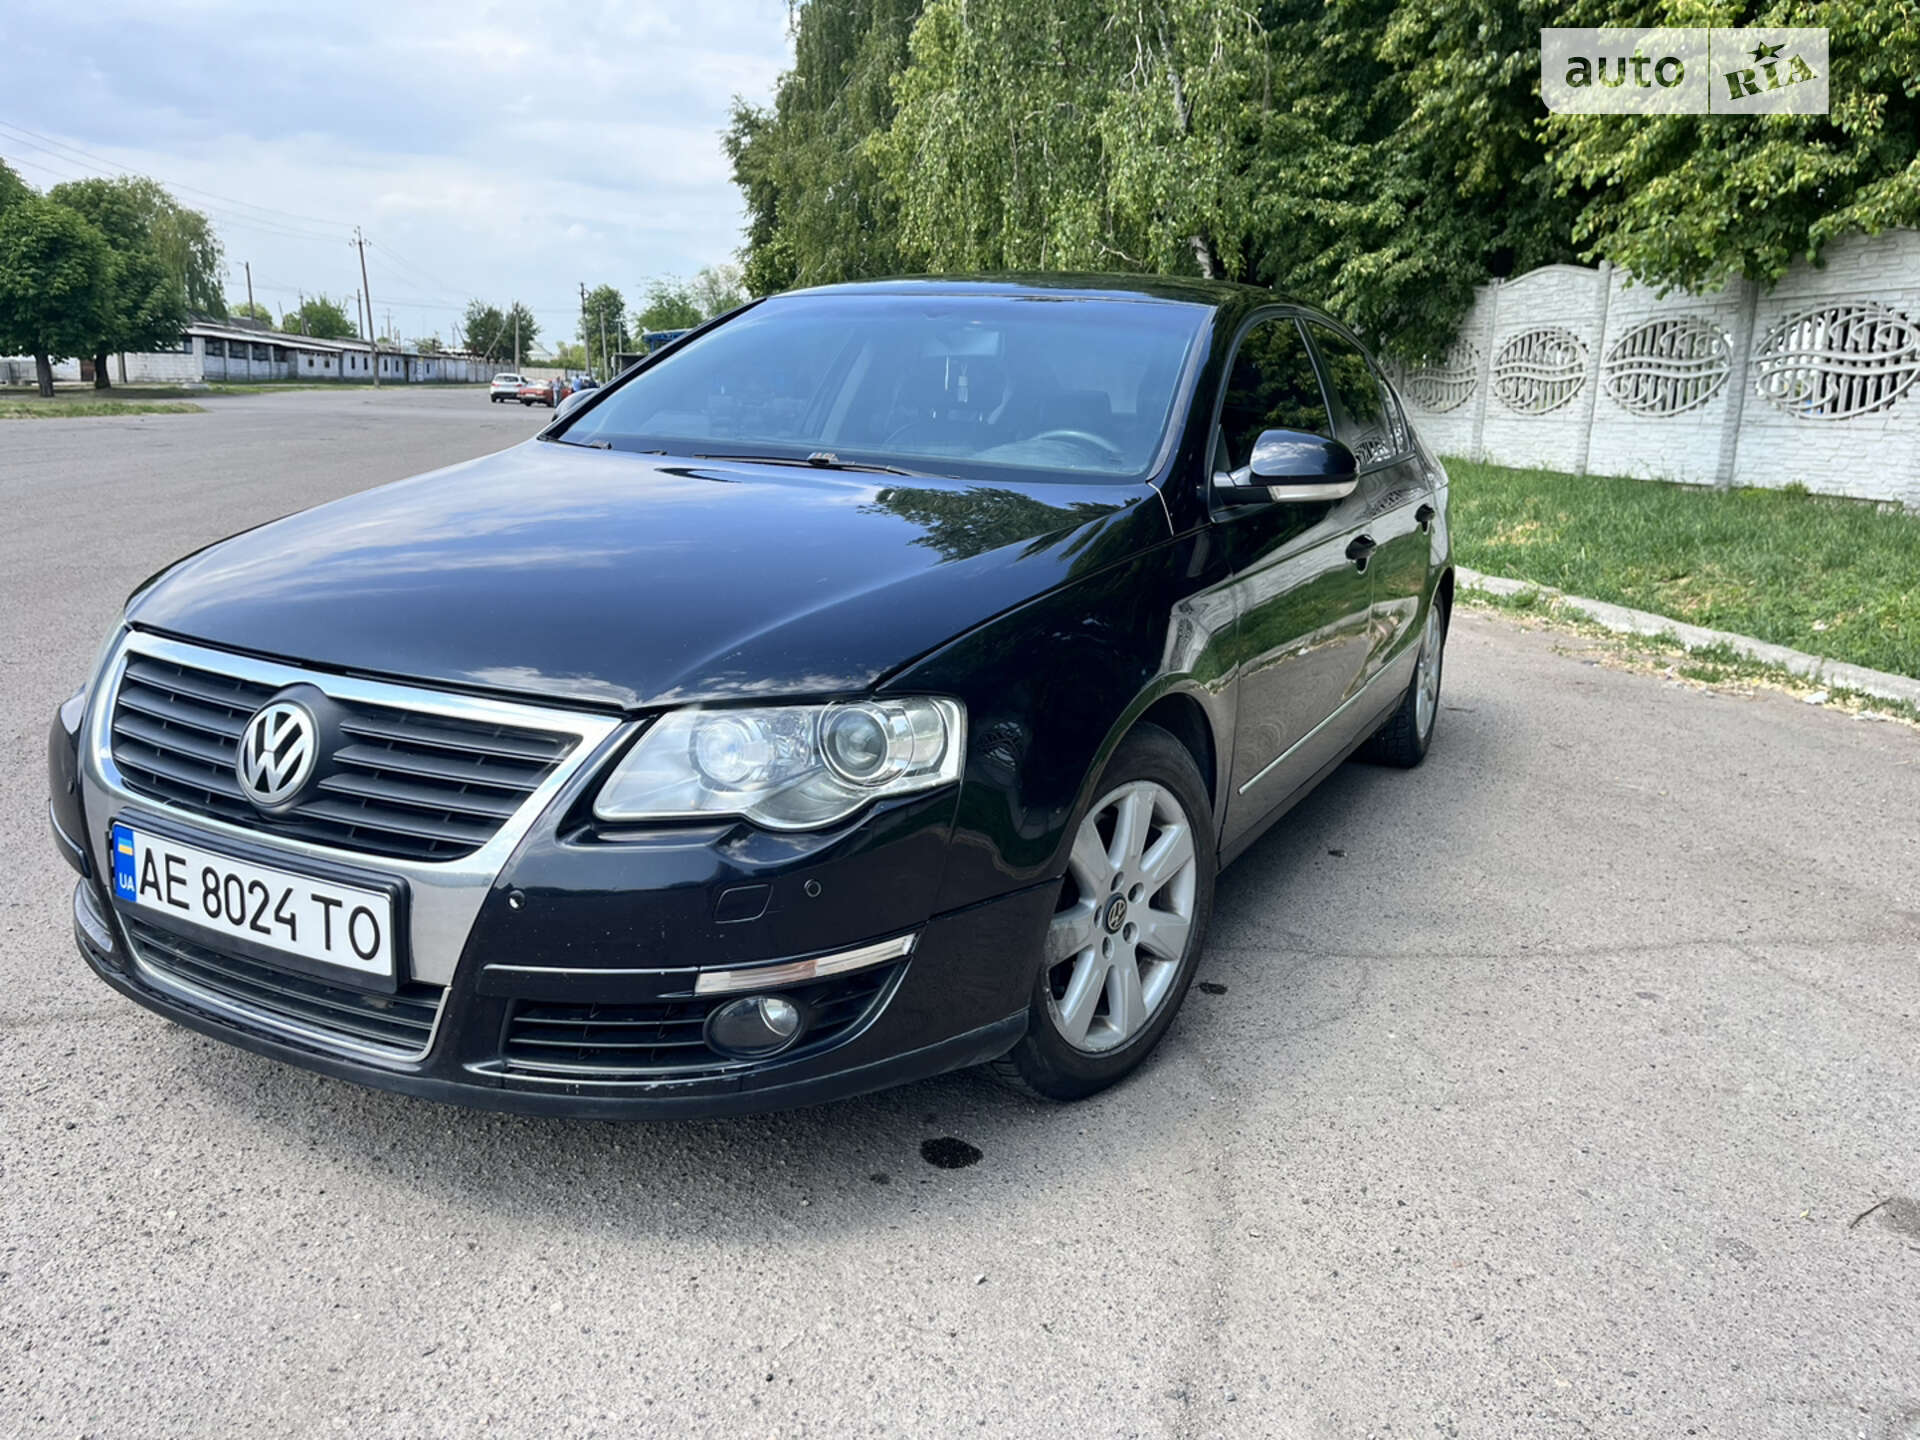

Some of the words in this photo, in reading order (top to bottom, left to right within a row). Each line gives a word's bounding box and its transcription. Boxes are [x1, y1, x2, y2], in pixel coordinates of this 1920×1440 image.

[118, 872, 135, 893] UA
[139, 847, 190, 911] AE
[201, 866, 298, 942] 8024
[310, 893, 382, 961] TO
